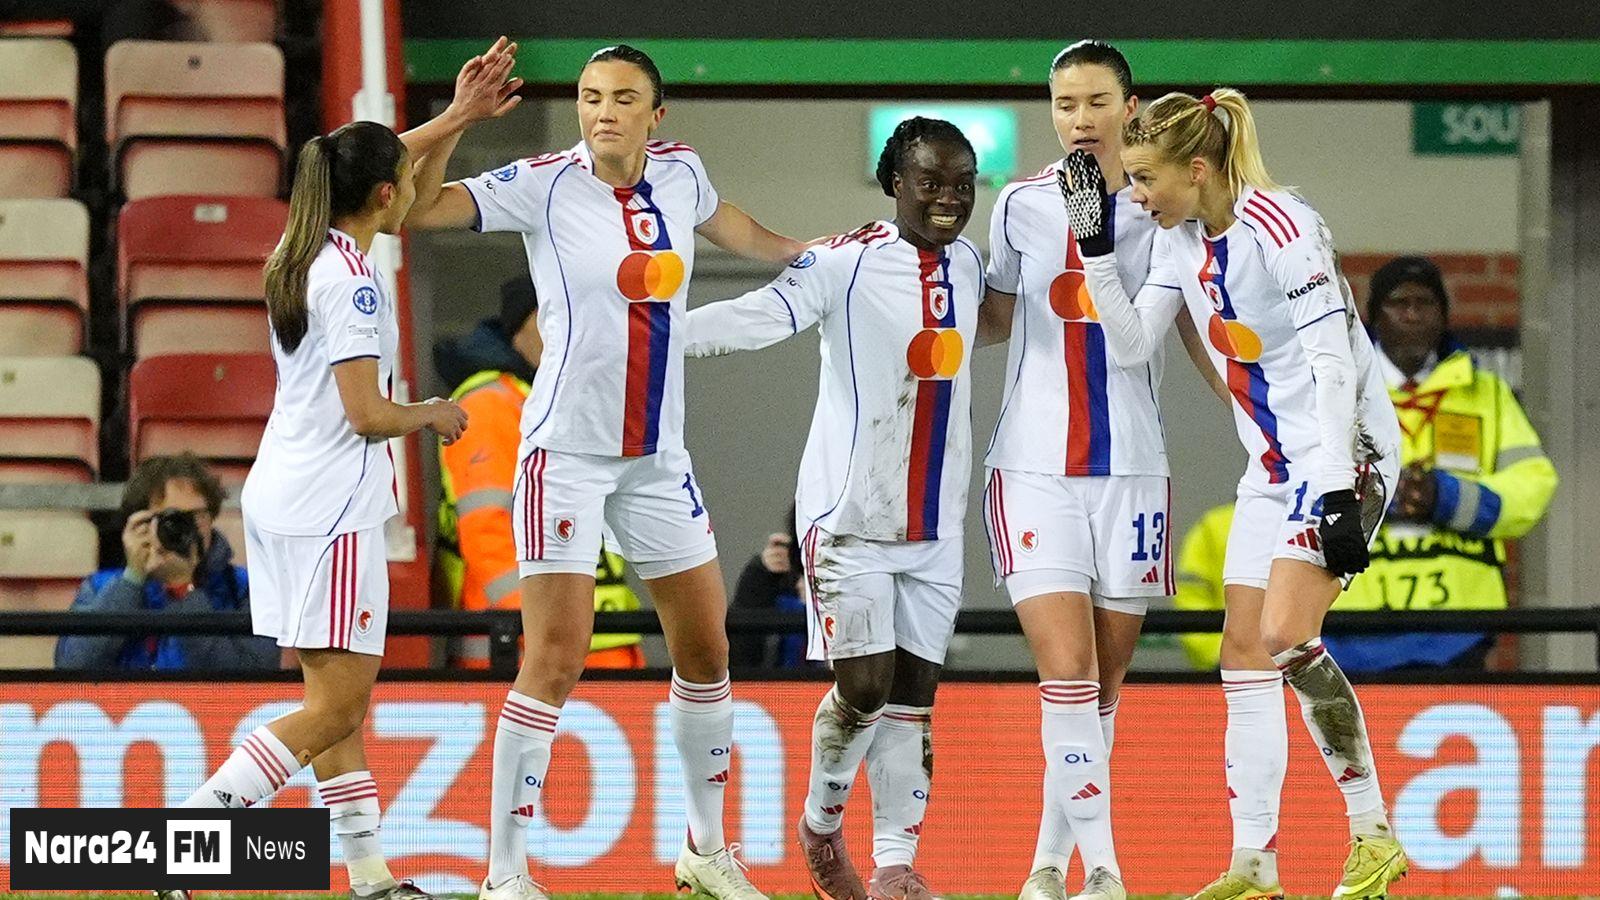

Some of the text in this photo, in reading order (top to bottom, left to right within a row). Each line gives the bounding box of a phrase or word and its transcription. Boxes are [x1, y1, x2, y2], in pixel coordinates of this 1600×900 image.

[1131, 511, 1164, 561] 13
[1378, 570, 1450, 610] 173
[1064, 752, 1094, 764] OL
